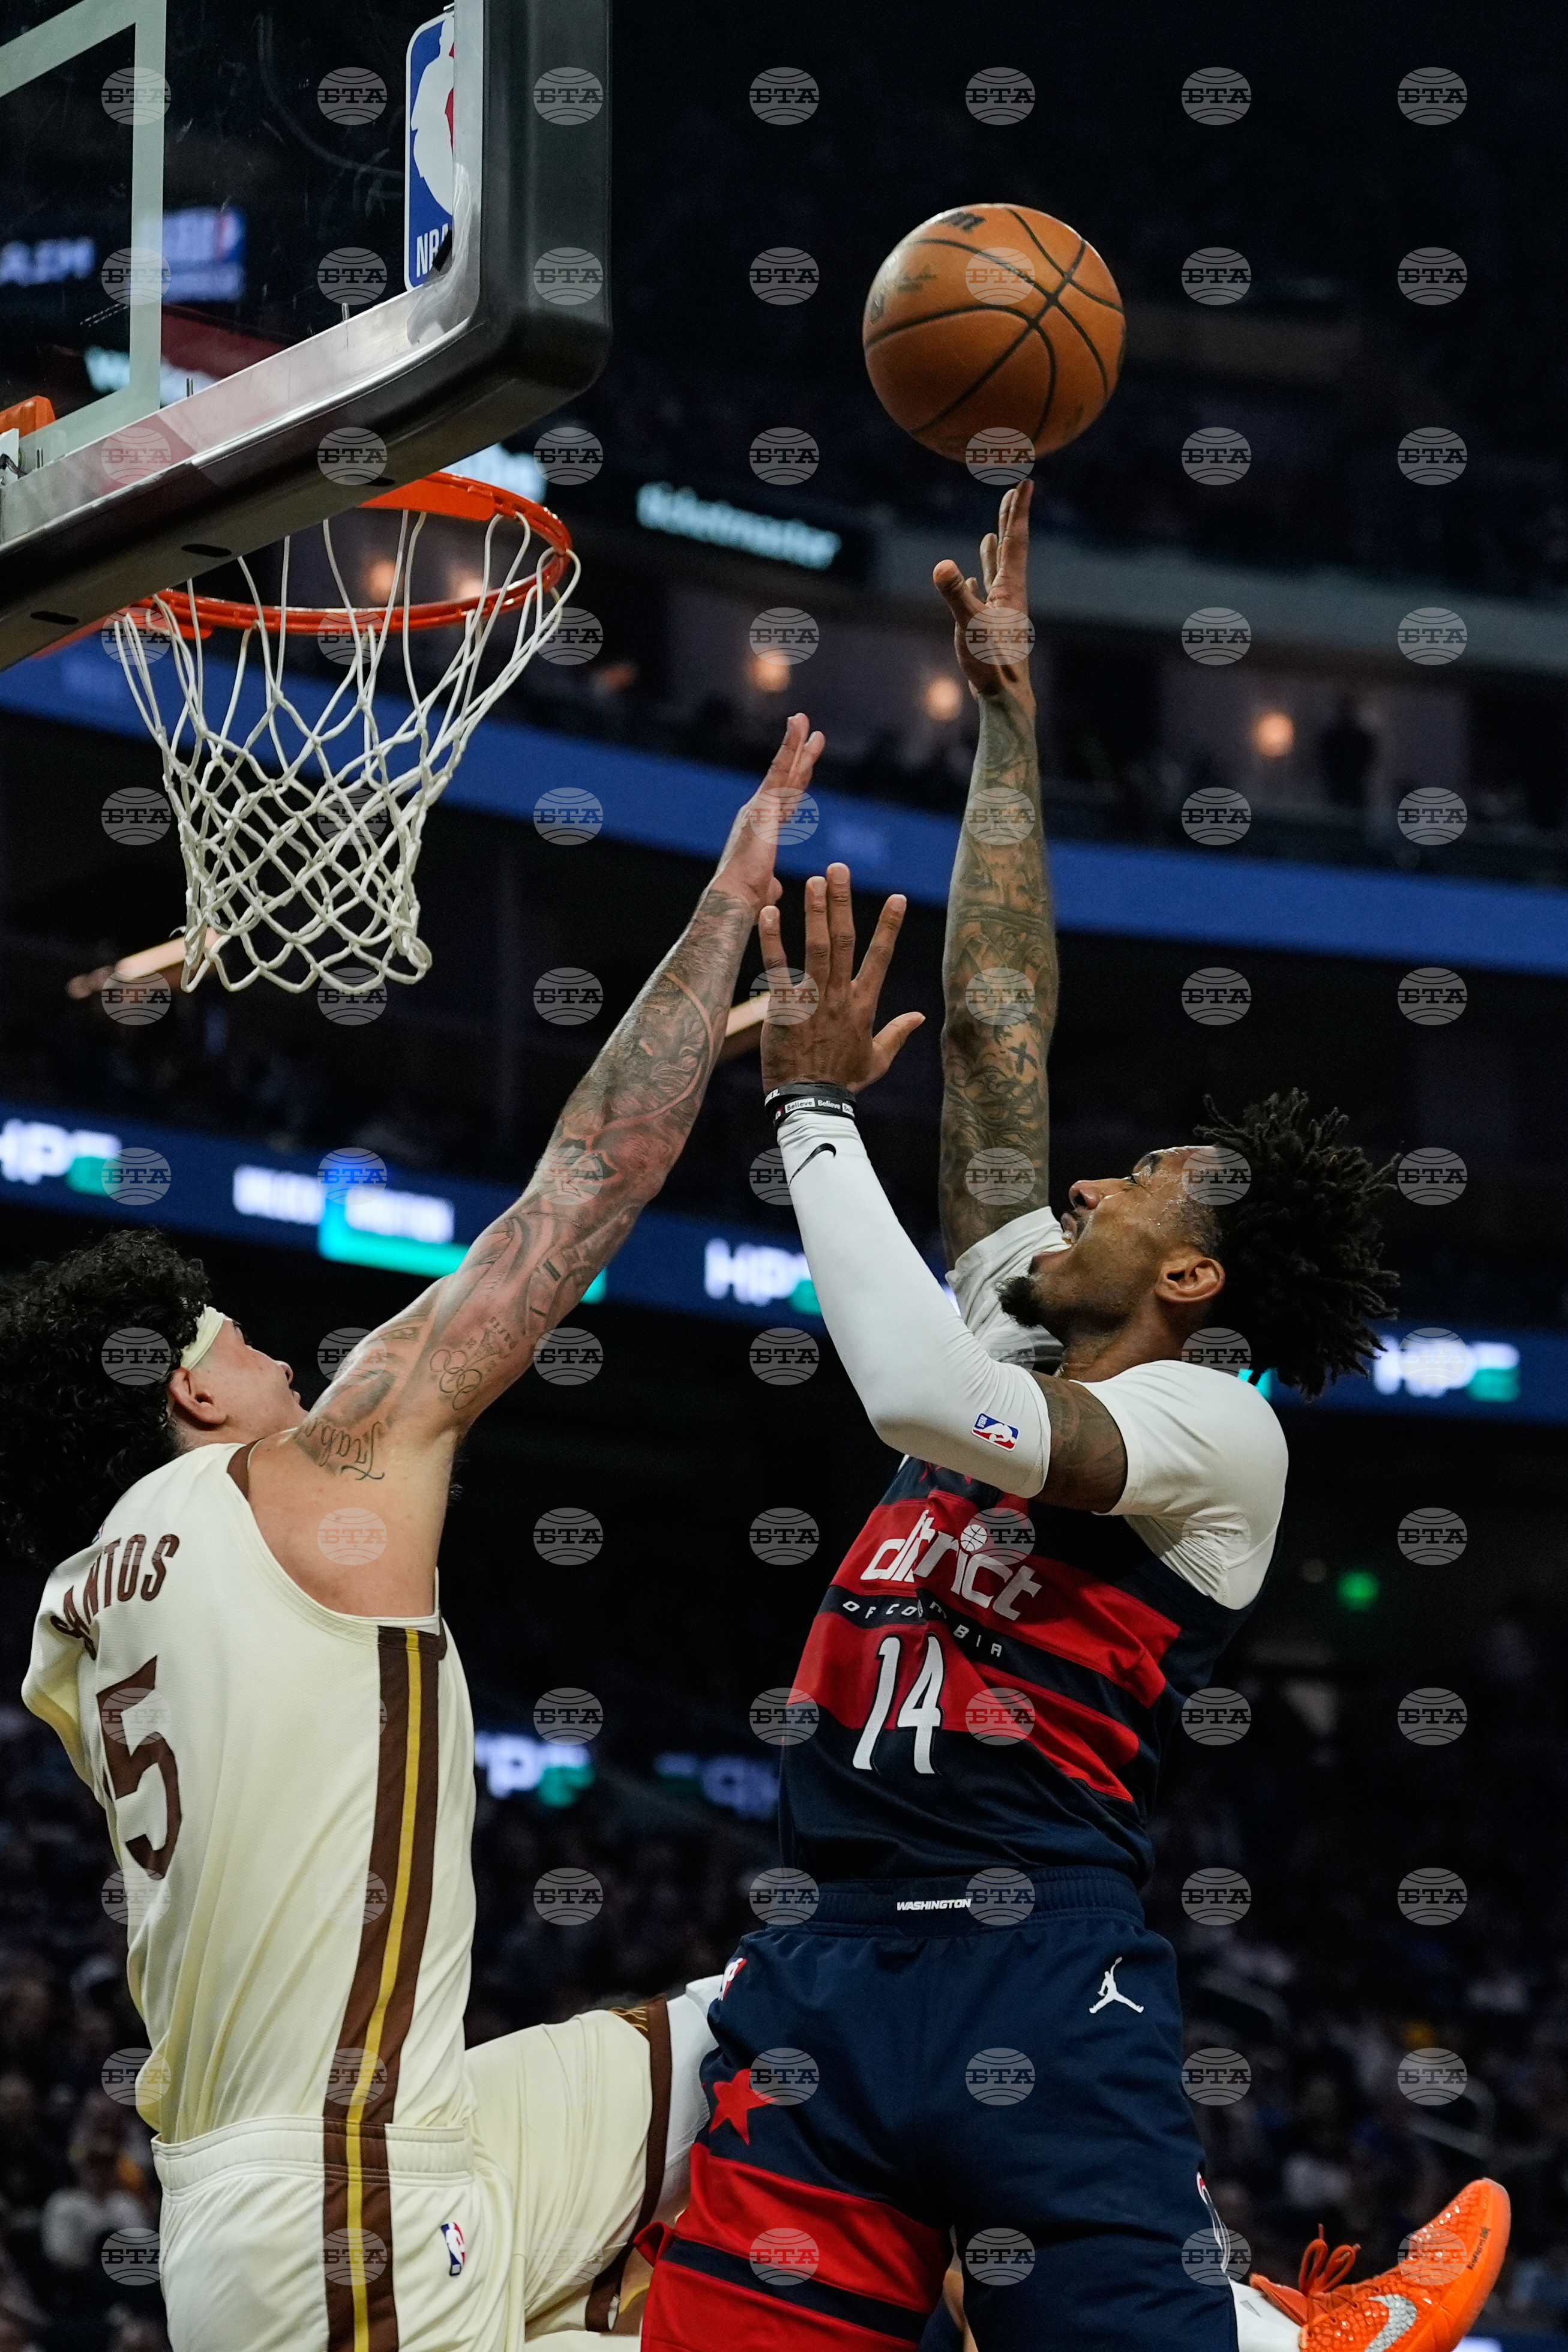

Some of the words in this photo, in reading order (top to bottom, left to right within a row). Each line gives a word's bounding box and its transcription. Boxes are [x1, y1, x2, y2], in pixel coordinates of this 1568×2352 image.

[787, 1101, 813, 1111] Believe
[817, 1099, 841, 1110] Believe
[50, 1534, 179, 1661] SANTOS
[843, 1601, 876, 1619] OF
[852, 1636, 944, 1774] 14
[96, 1655, 182, 1881] 5
[897, 1898, 972, 1911] WASHINGTON
